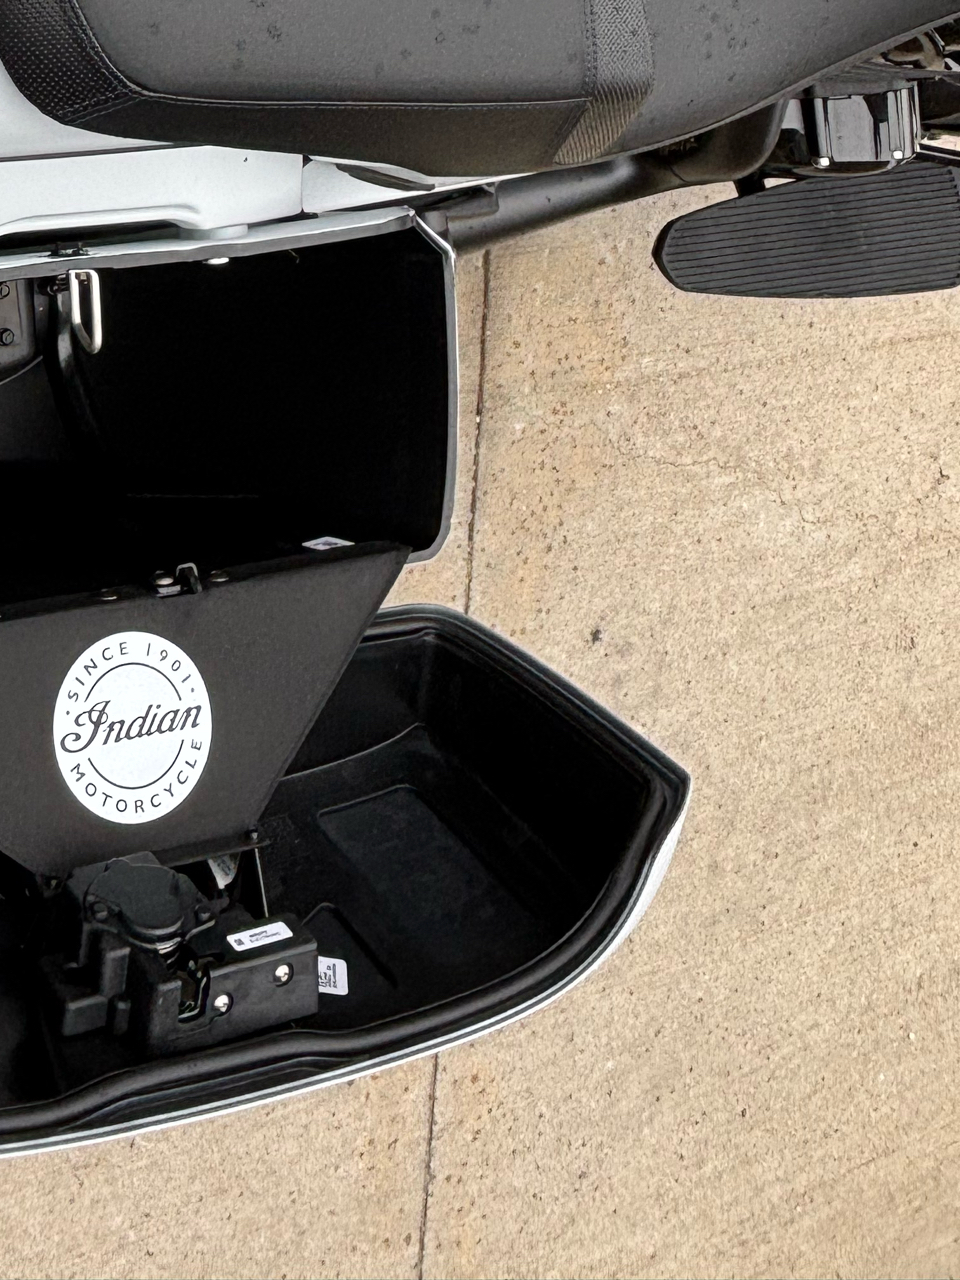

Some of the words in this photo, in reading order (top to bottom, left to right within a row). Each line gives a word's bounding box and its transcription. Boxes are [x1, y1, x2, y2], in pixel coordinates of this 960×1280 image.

[67, 641, 129, 702] SINCE
[146, 642, 191, 683] 1901
[60, 700, 202, 753] Indian
[70, 738, 202, 814] MOTORCYCLE
